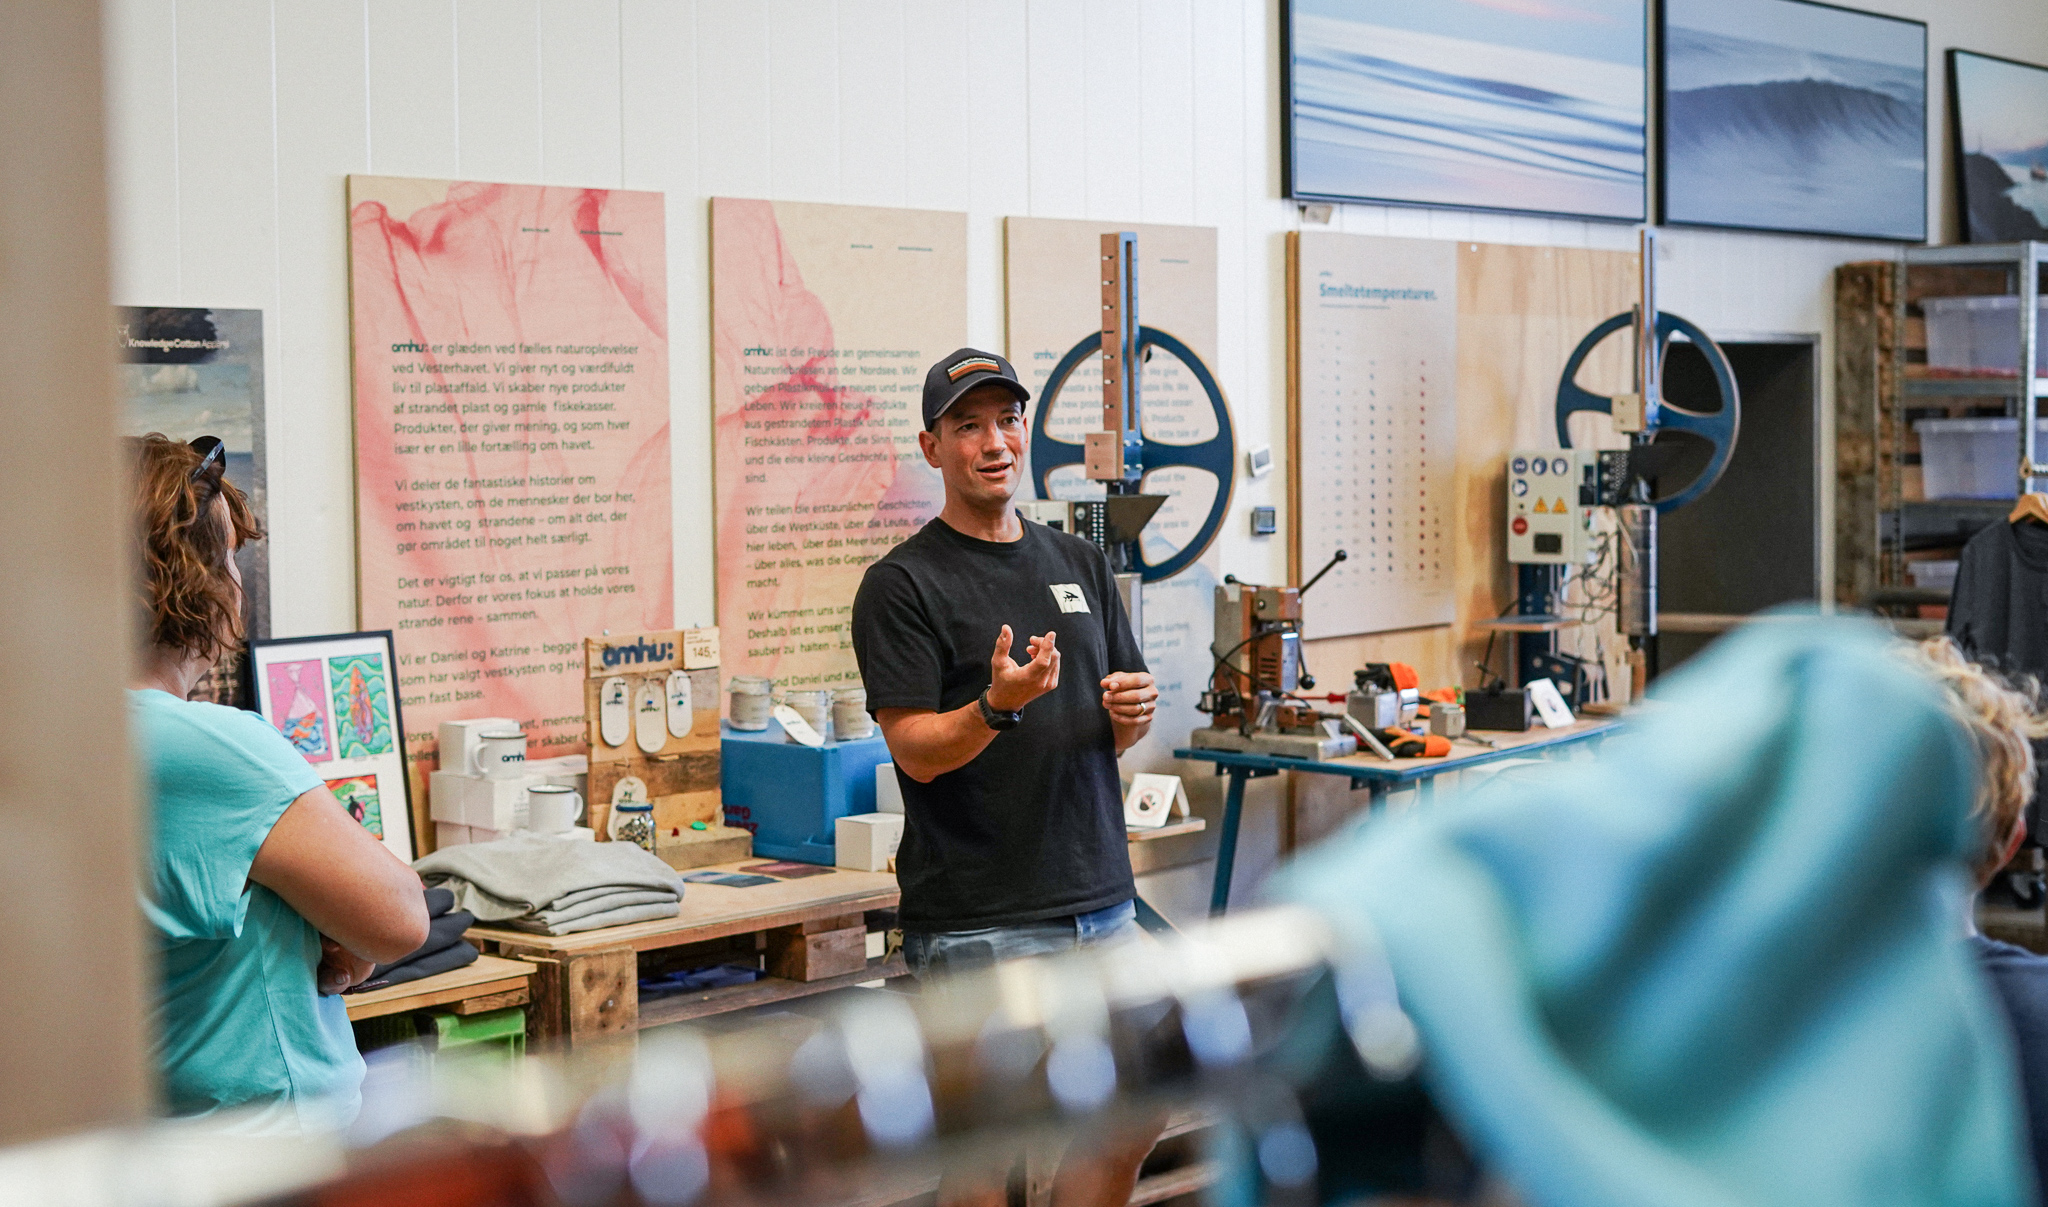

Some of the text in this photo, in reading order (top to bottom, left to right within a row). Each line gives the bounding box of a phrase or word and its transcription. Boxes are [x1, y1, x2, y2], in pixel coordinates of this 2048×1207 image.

[430, 345, 443, 353] er
[446, 342, 491, 355] glæden
[494, 343, 516, 353] ved
[518, 343, 552, 354] fælles
[392, 363, 414, 373] ved
[493, 363, 505, 373] Vi
[507, 363, 536, 376] giver
[539, 364, 558, 376] nyt
[560, 366, 576, 376] og
[578, 363, 635, 373] værdifuldt
[393, 382, 406, 393] liv
[409, 382, 421, 393] til
[492, 382, 505, 393] Vi
[507, 382, 545, 393] skaber
[548, 385, 569, 395] nye
[571, 382, 626, 395] produkter
[394, 403, 405, 413] af
[407, 402, 458, 413] strandet
[461, 402, 490, 415] plast
[492, 404, 508, 415] og
[511, 401, 547, 414] gamle
[458, 422, 478, 432] der
[481, 421, 510, 435] giver
[562, 423, 578, 433] og
[580, 422, 604, 430] som
[606, 419, 630, 430] hver
[394, 443, 419, 454] især
[438, 445, 454, 453] en
[457, 442, 477, 453] lille
[480, 441, 537, 453] fortælling
[539, 443, 558, 451] om
[395, 475, 596, 491] Vi deler de fantastiske historier om
[465, 501, 486, 509] om
[488, 497, 504, 508] de
[506, 495, 569, 507] mennesker
[572, 494, 590, 505] der
[593, 493, 612, 504] bor
[396, 523, 416, 531] om
[418, 520, 452, 531] havet
[455, 521, 471, 531] og
[477, 516, 535, 528] strandene
[546, 517, 566, 525] om
[568, 513, 582, 524] alt
[609, 512, 627, 522] der
[397, 543, 417, 554] gør
[419, 538, 471, 550] området
[473, 536, 486, 547] til
[488, 536, 522, 549] noget
[525, 534, 547, 545] helt
[398, 578, 419, 589] Det
[422, 579, 434, 587] er
[438, 574, 476, 588] vigtigt
[478, 573, 495, 584] for
[517, 572, 529, 581] at
[532, 569, 542, 580] vi
[544, 570, 580, 582] passer
[583, 566, 598, 580] på
[600, 567, 629, 576] vores
[435, 594, 473, 606] Derfor
[476, 595, 488, 603] er
[491, 593, 522, 602] vores
[524, 589, 556, 600] fokus
[558, 588, 569, 598] at
[572, 585, 603, 597] holde
[606, 585, 635, 595] vores
[399, 616, 444, 629] strande
[447, 616, 474, 626] rene
[399, 654, 411, 665] Vi
[414, 656, 426, 664] er
[429, 650, 468, 663] Daniel
[470, 651, 486, 661] og
[489, 645, 530, 658] Katrine
[541, 643, 578, 655] begge
[400, 664, 563, 685] som har valgt vestkysten og
[428, 692, 451, 703] fast
